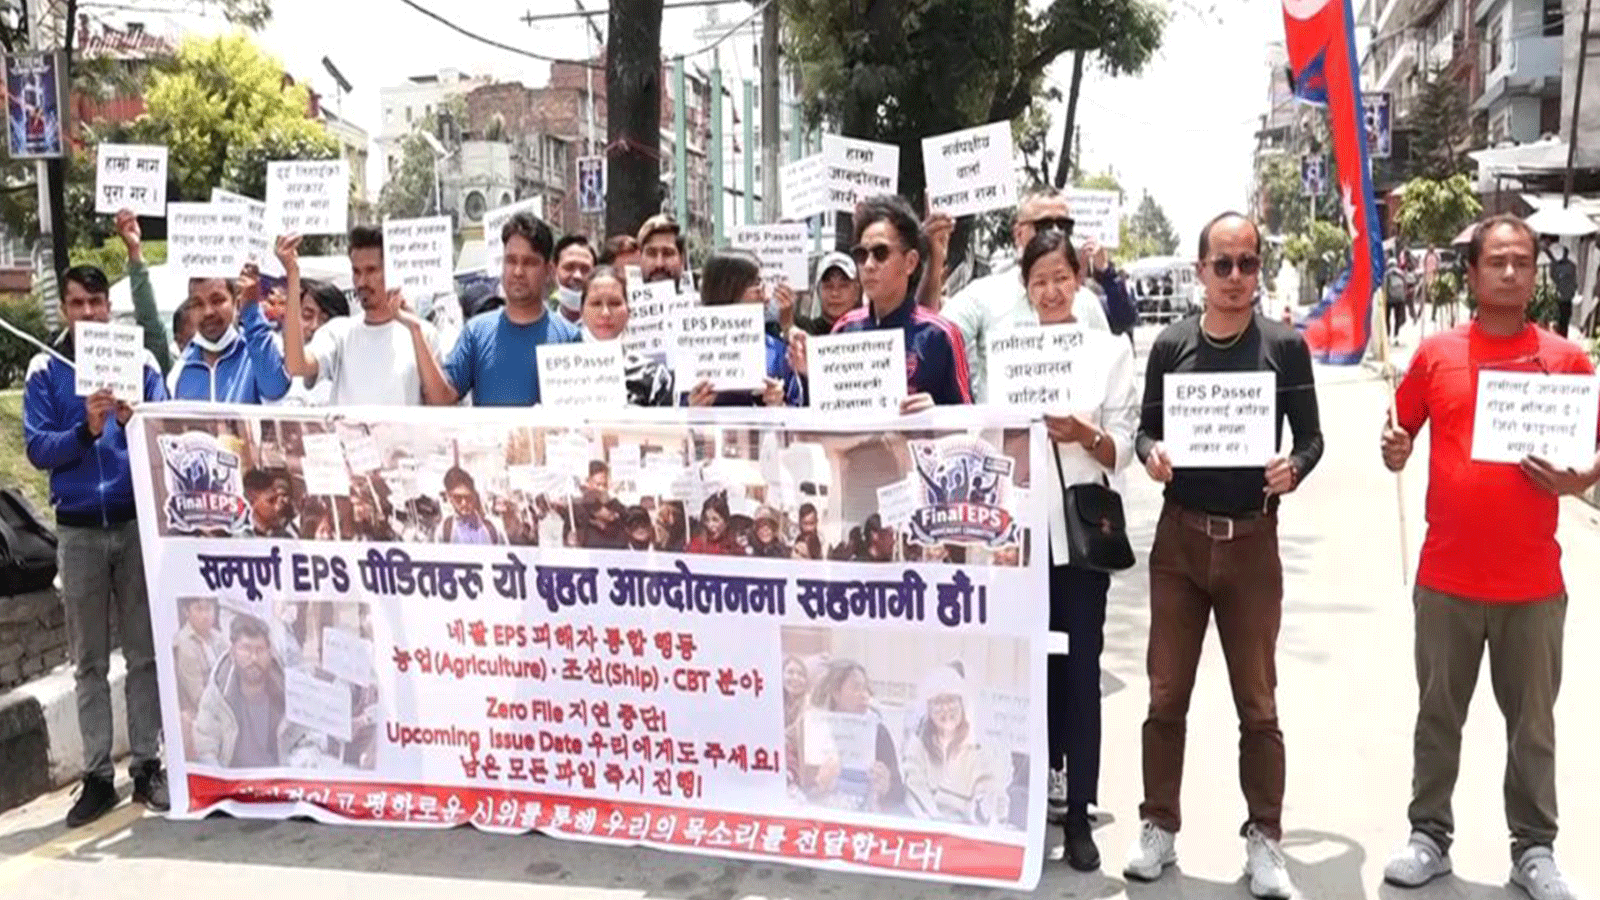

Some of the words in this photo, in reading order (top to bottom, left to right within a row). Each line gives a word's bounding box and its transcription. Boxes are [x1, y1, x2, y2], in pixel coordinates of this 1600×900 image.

[105, 152, 131, 173] हाम्रो
[137, 157, 159, 172] माग
[846, 146, 874, 163] हाम्रो
[828, 165, 891, 188] आन्दोलन
[103, 184, 125, 204] पूरा
[682, 317, 707, 331] EPS
[711, 316, 753, 330] Passer
[991, 332, 1045, 353] हामीलाई
[546, 355, 571, 371] EPS
[574, 353, 615, 369] Passer
[1176, 384, 1207, 400] EPS
[1212, 384, 1262, 399] Passer
[176, 493, 209, 511] Final
[210, 494, 238, 512] EPS
[921, 504, 963, 526] Final
[967, 505, 1001, 528] EPS
[198, 546, 282, 601] सम्पूर्ण
[292, 553, 351, 593] EPS
[492, 552, 527, 600] यो
[607, 559, 788, 615] आन्दोलनमा
[796, 569, 928, 622] सहभागी
[446, 618, 488, 647] 네팔
[493, 624, 528, 648] EPS
[532, 622, 598, 653] 피해자
[603, 627, 647, 657] 통합
[653, 631, 698, 662] 행동
[673, 667, 711, 693] CBT
[715, 667, 764, 698] 분야
[486, 695, 528, 721] Zero
[531, 699, 564, 723] File
[569, 698, 611, 728] 지연
[386, 721, 480, 754] Upcoming
[489, 726, 535, 751] Issue
[539, 730, 583, 755] Date
[588, 731, 699, 765] 우리에게도
[460, 753, 500, 780] 남은
[507, 757, 548, 784] 모든
[555, 758, 597, 789] 파일
[603, 763, 644, 795] 즉시
[364, 790, 465, 821] 평화로운
[470, 796, 542, 828] 시위를
[551, 803, 597, 834] 통해
[602, 810, 676, 842] 우리의
[683, 816, 787, 853] 목소리를
